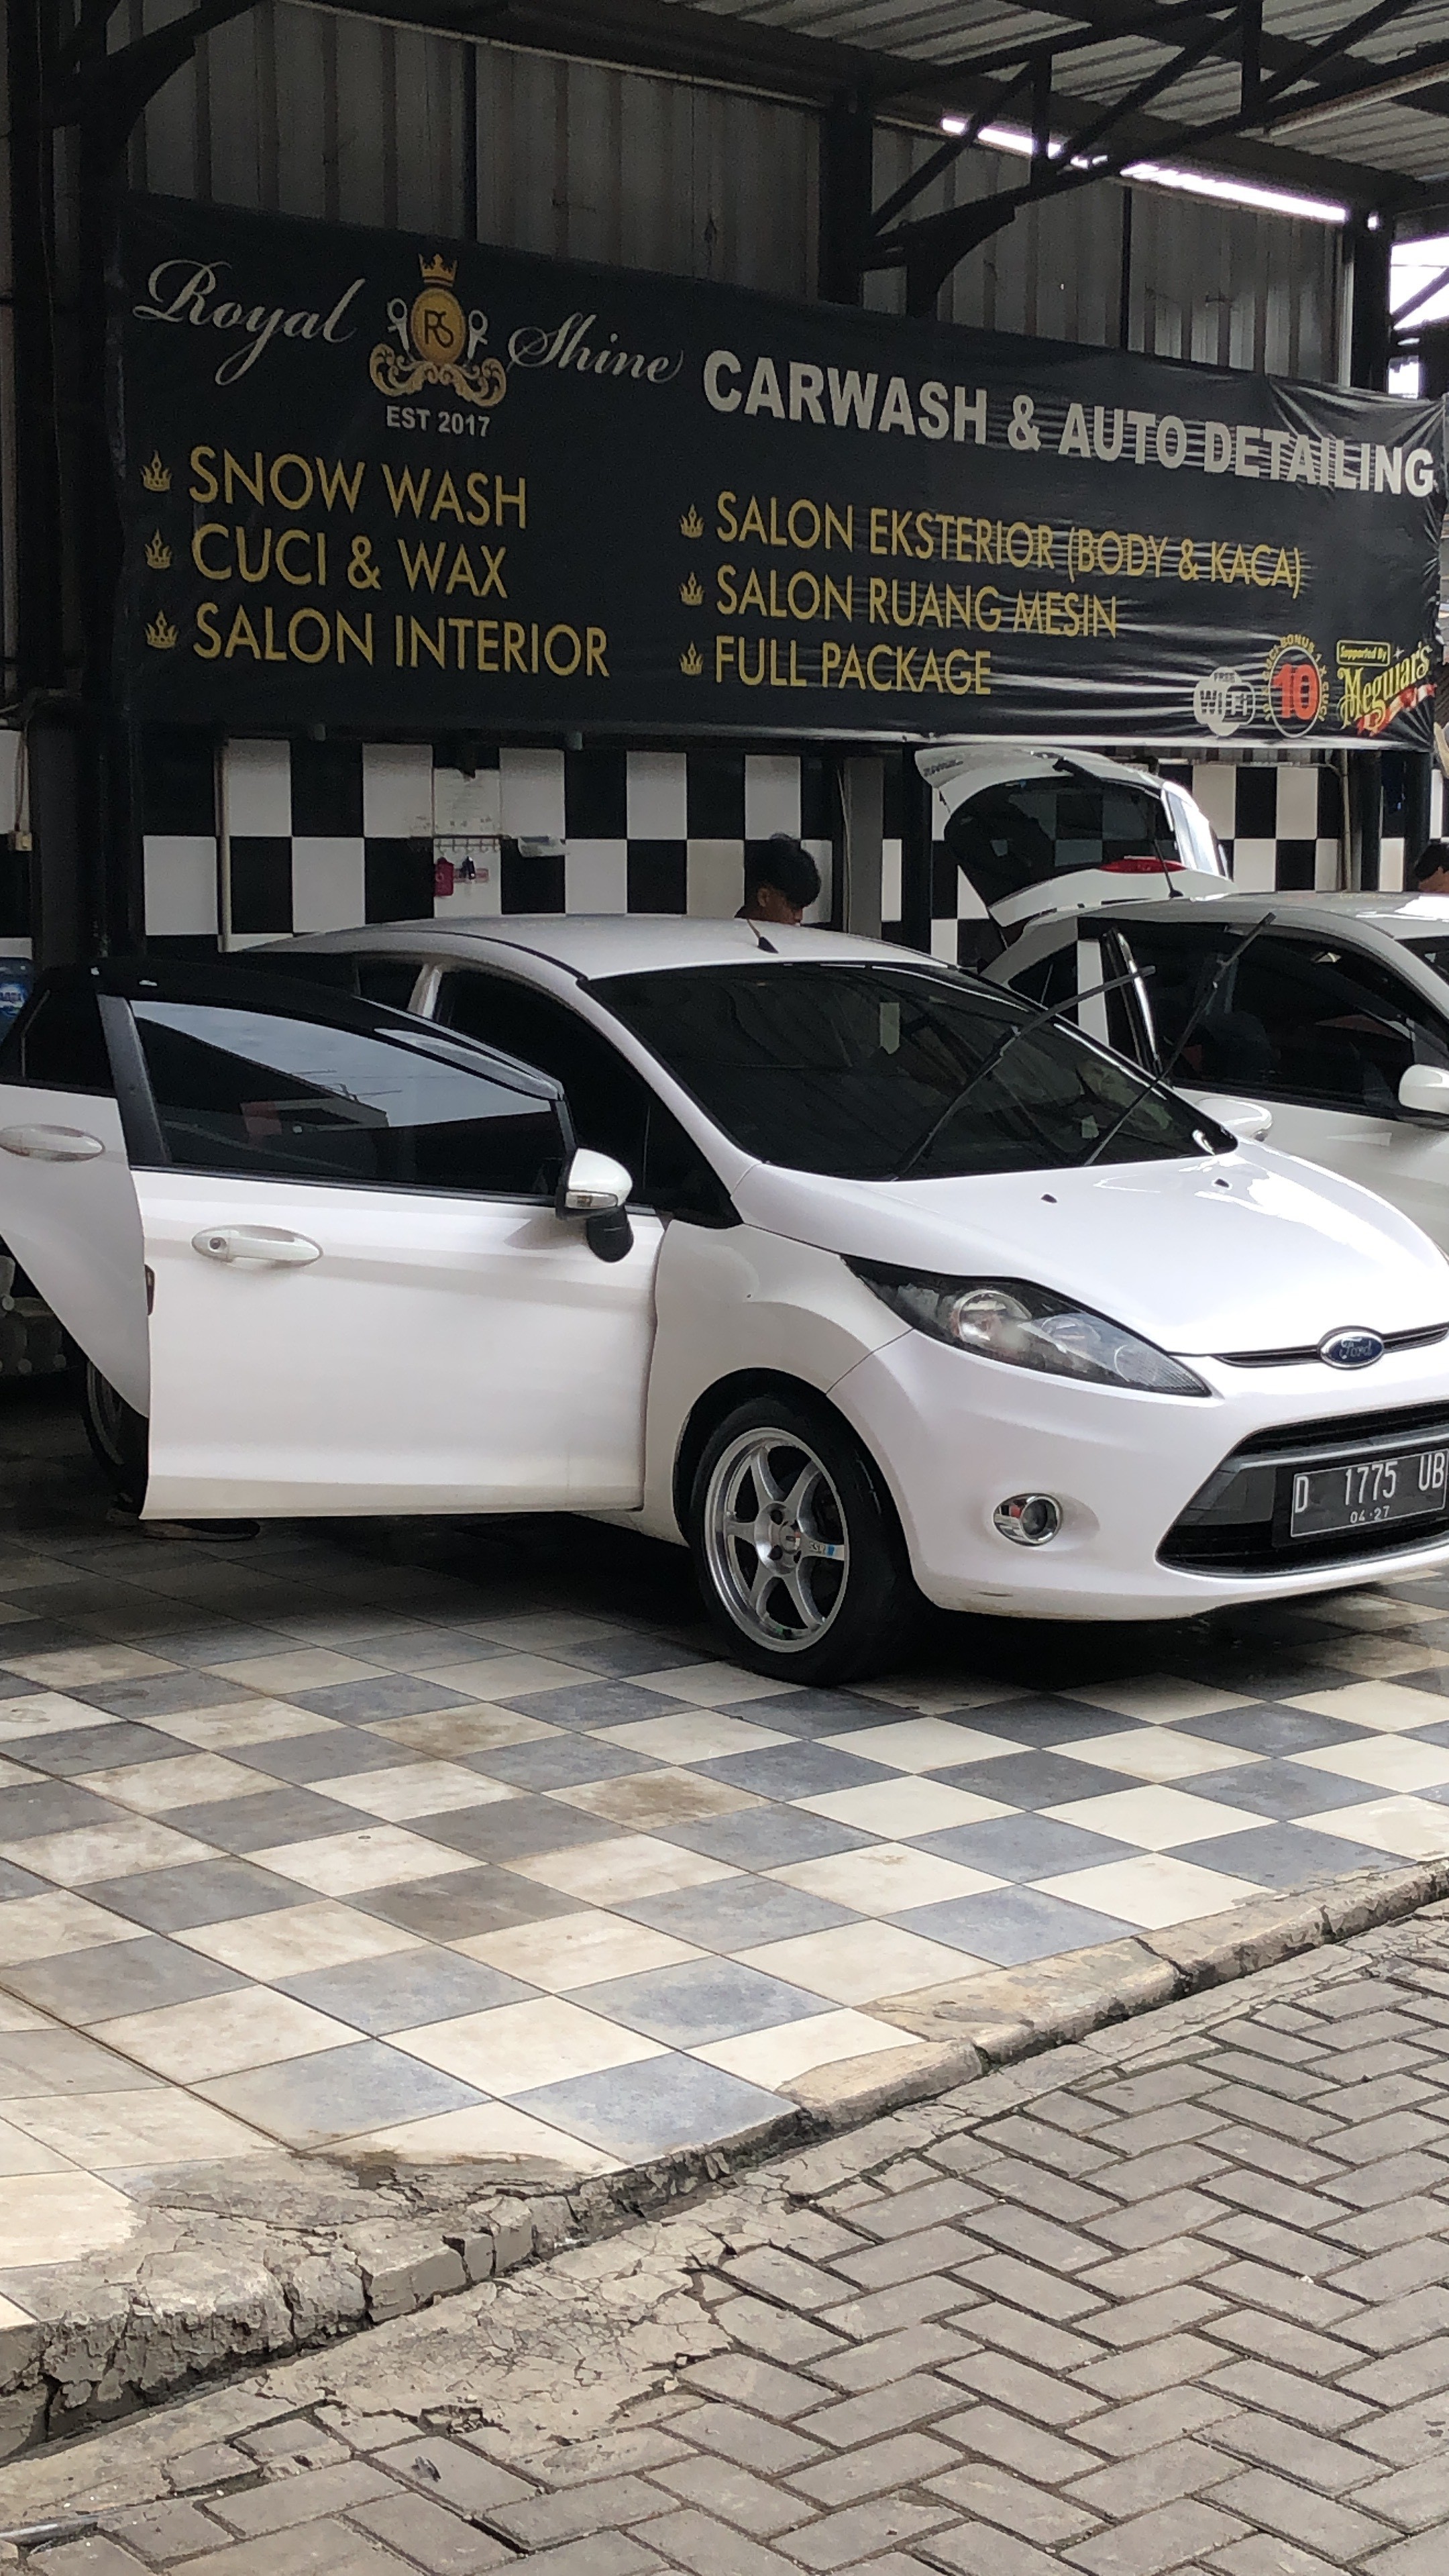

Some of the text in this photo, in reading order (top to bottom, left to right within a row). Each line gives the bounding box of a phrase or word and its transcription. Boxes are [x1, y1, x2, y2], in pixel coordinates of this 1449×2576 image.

[133, 259, 366, 386] Royal
[424, 309, 454, 348] RS
[506, 312, 684, 384] Shine
[386, 405, 490, 437] EST 2017
[703, 350, 1434, 498] CARWASH & AUTO DETAILING
[189, 445, 527, 530] SNOW WASH
[191, 523, 508, 599] CUCI & WAX
[716, 491, 1301, 599] SALON EKSTERIOR (BODY & KACA)
[716, 564, 1117, 639] SALON RUANG MESIN
[193, 602, 610, 678] SALON INTERIOR
[715, 635, 991, 696] FULL PACKAGE
[1271, 663, 1318, 720] 10
[1339, 1337, 1372, 1360] Ford
[1295, 1452, 1446, 1513] D 1775 UB
